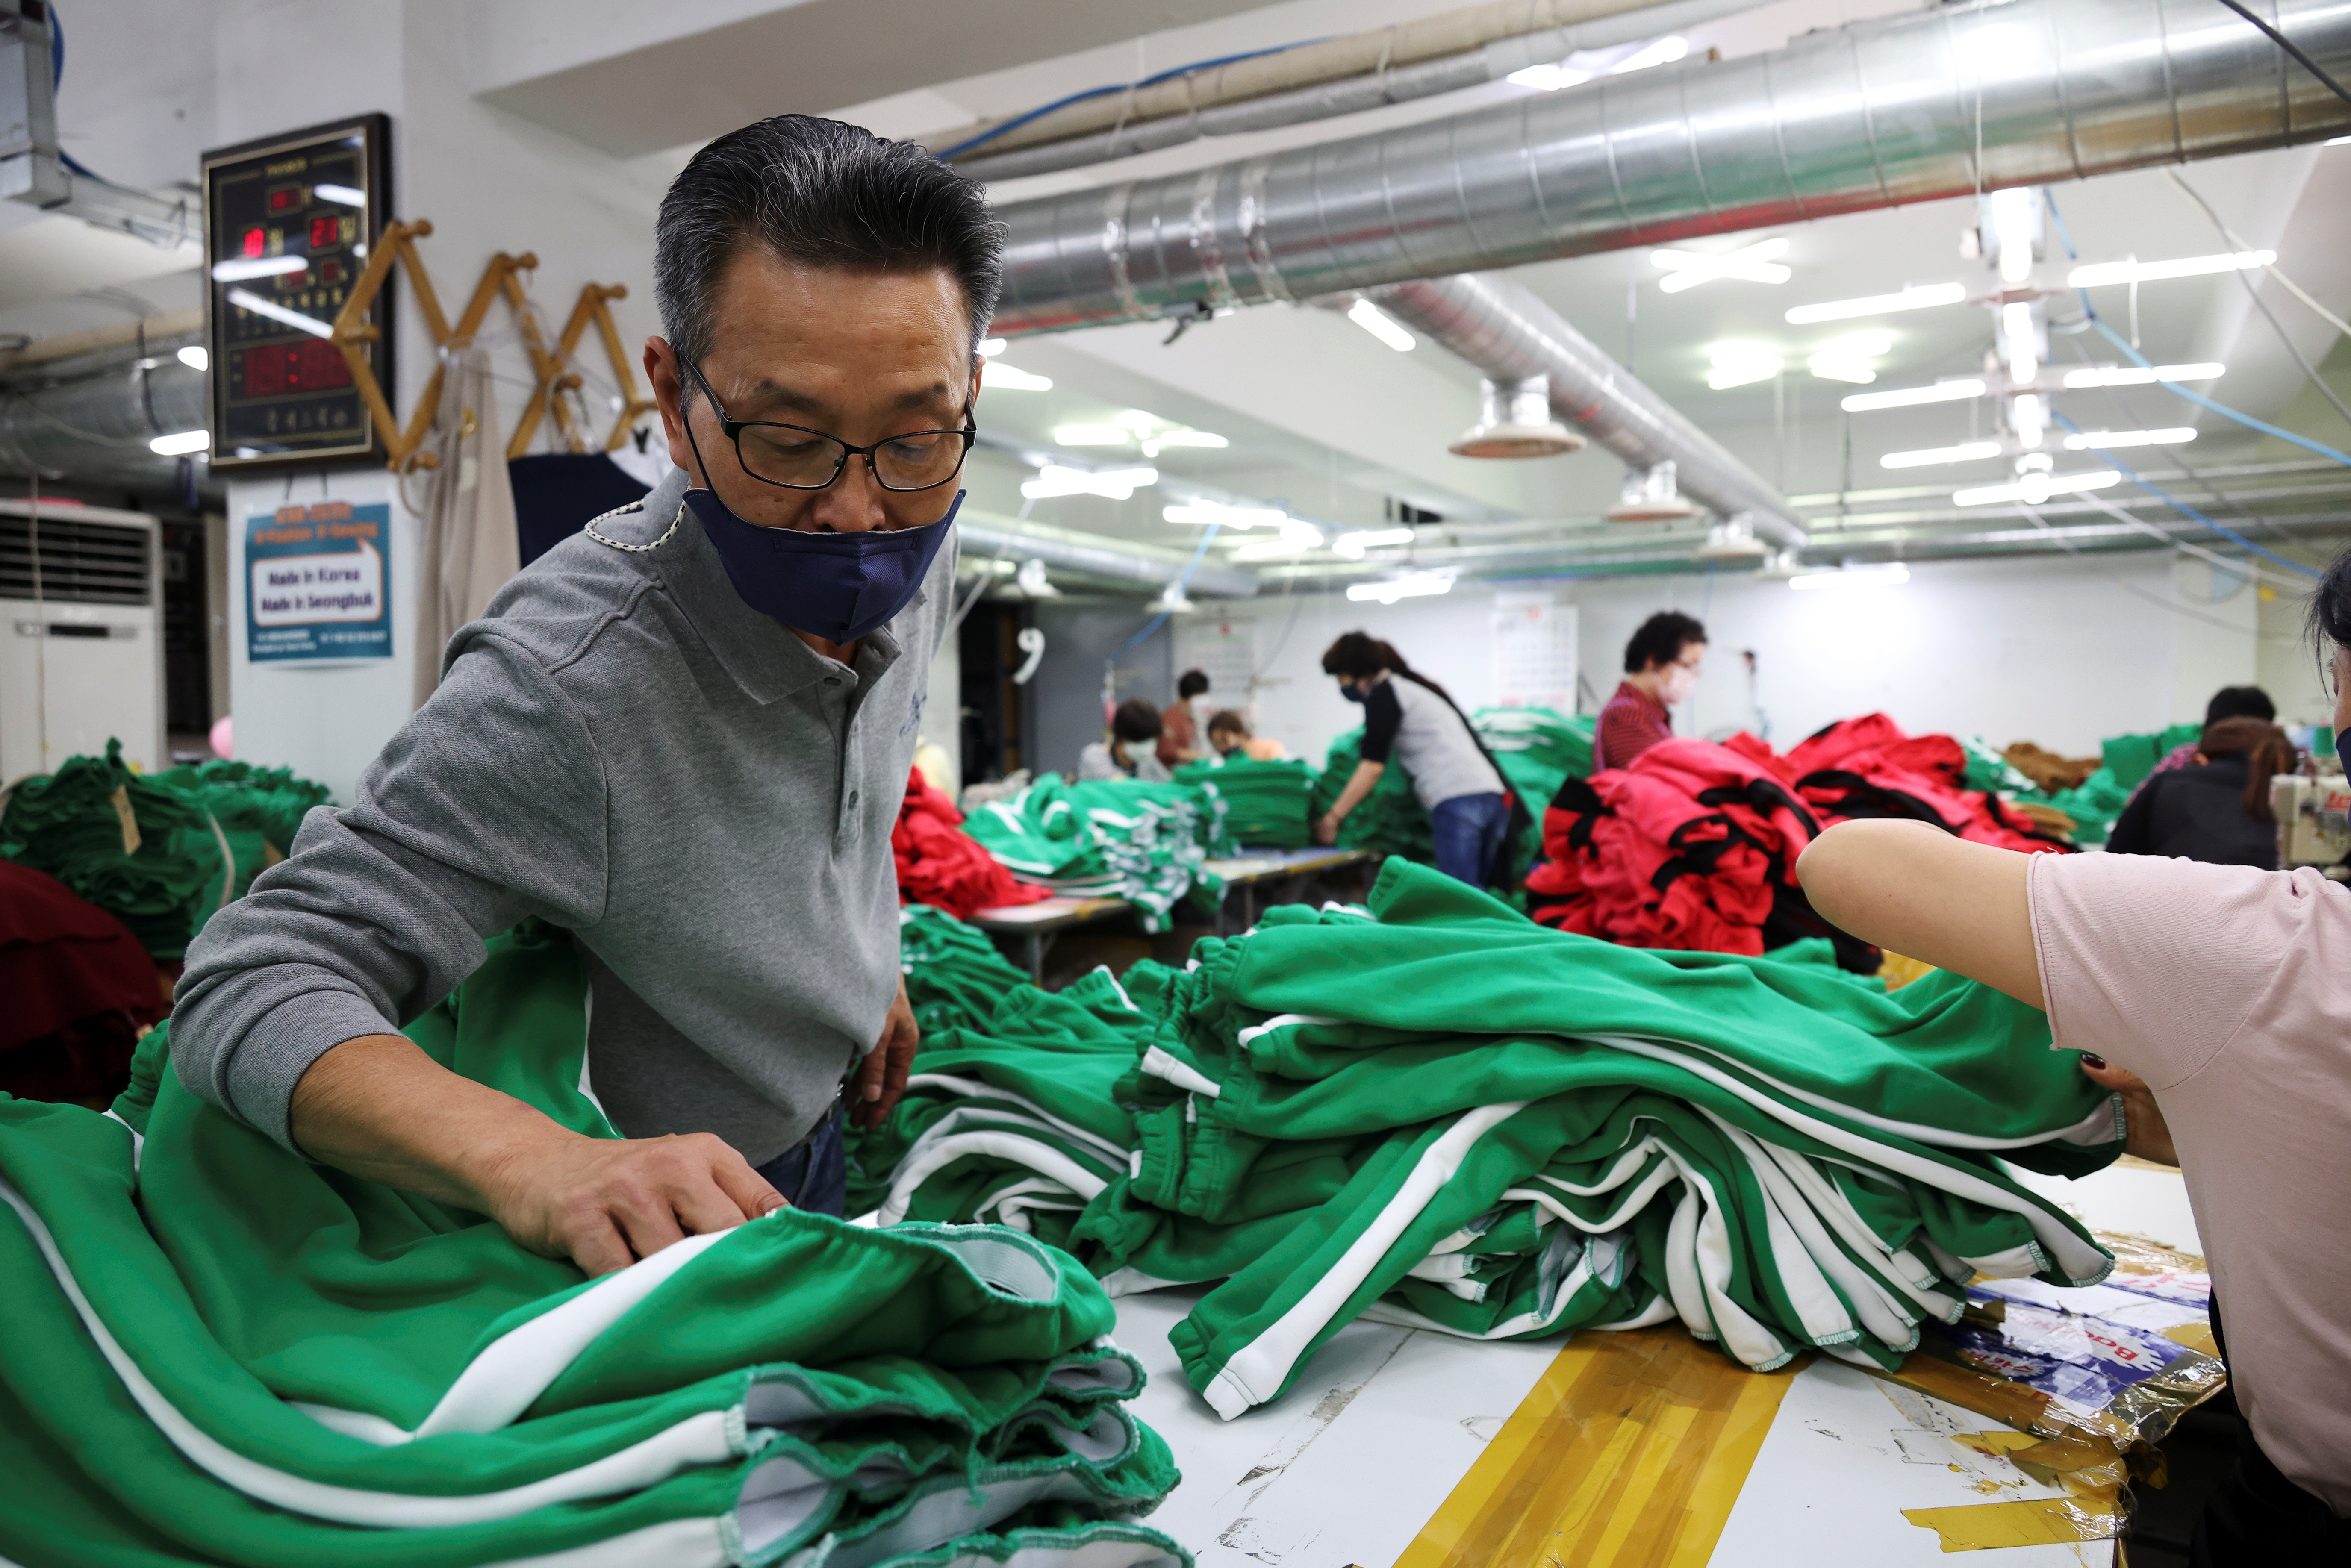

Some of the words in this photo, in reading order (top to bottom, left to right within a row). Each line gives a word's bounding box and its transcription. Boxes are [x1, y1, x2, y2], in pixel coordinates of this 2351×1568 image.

[269, 570, 299, 585] Made
[318, 568, 360, 582] Korea
[262, 597, 290, 611] Made
